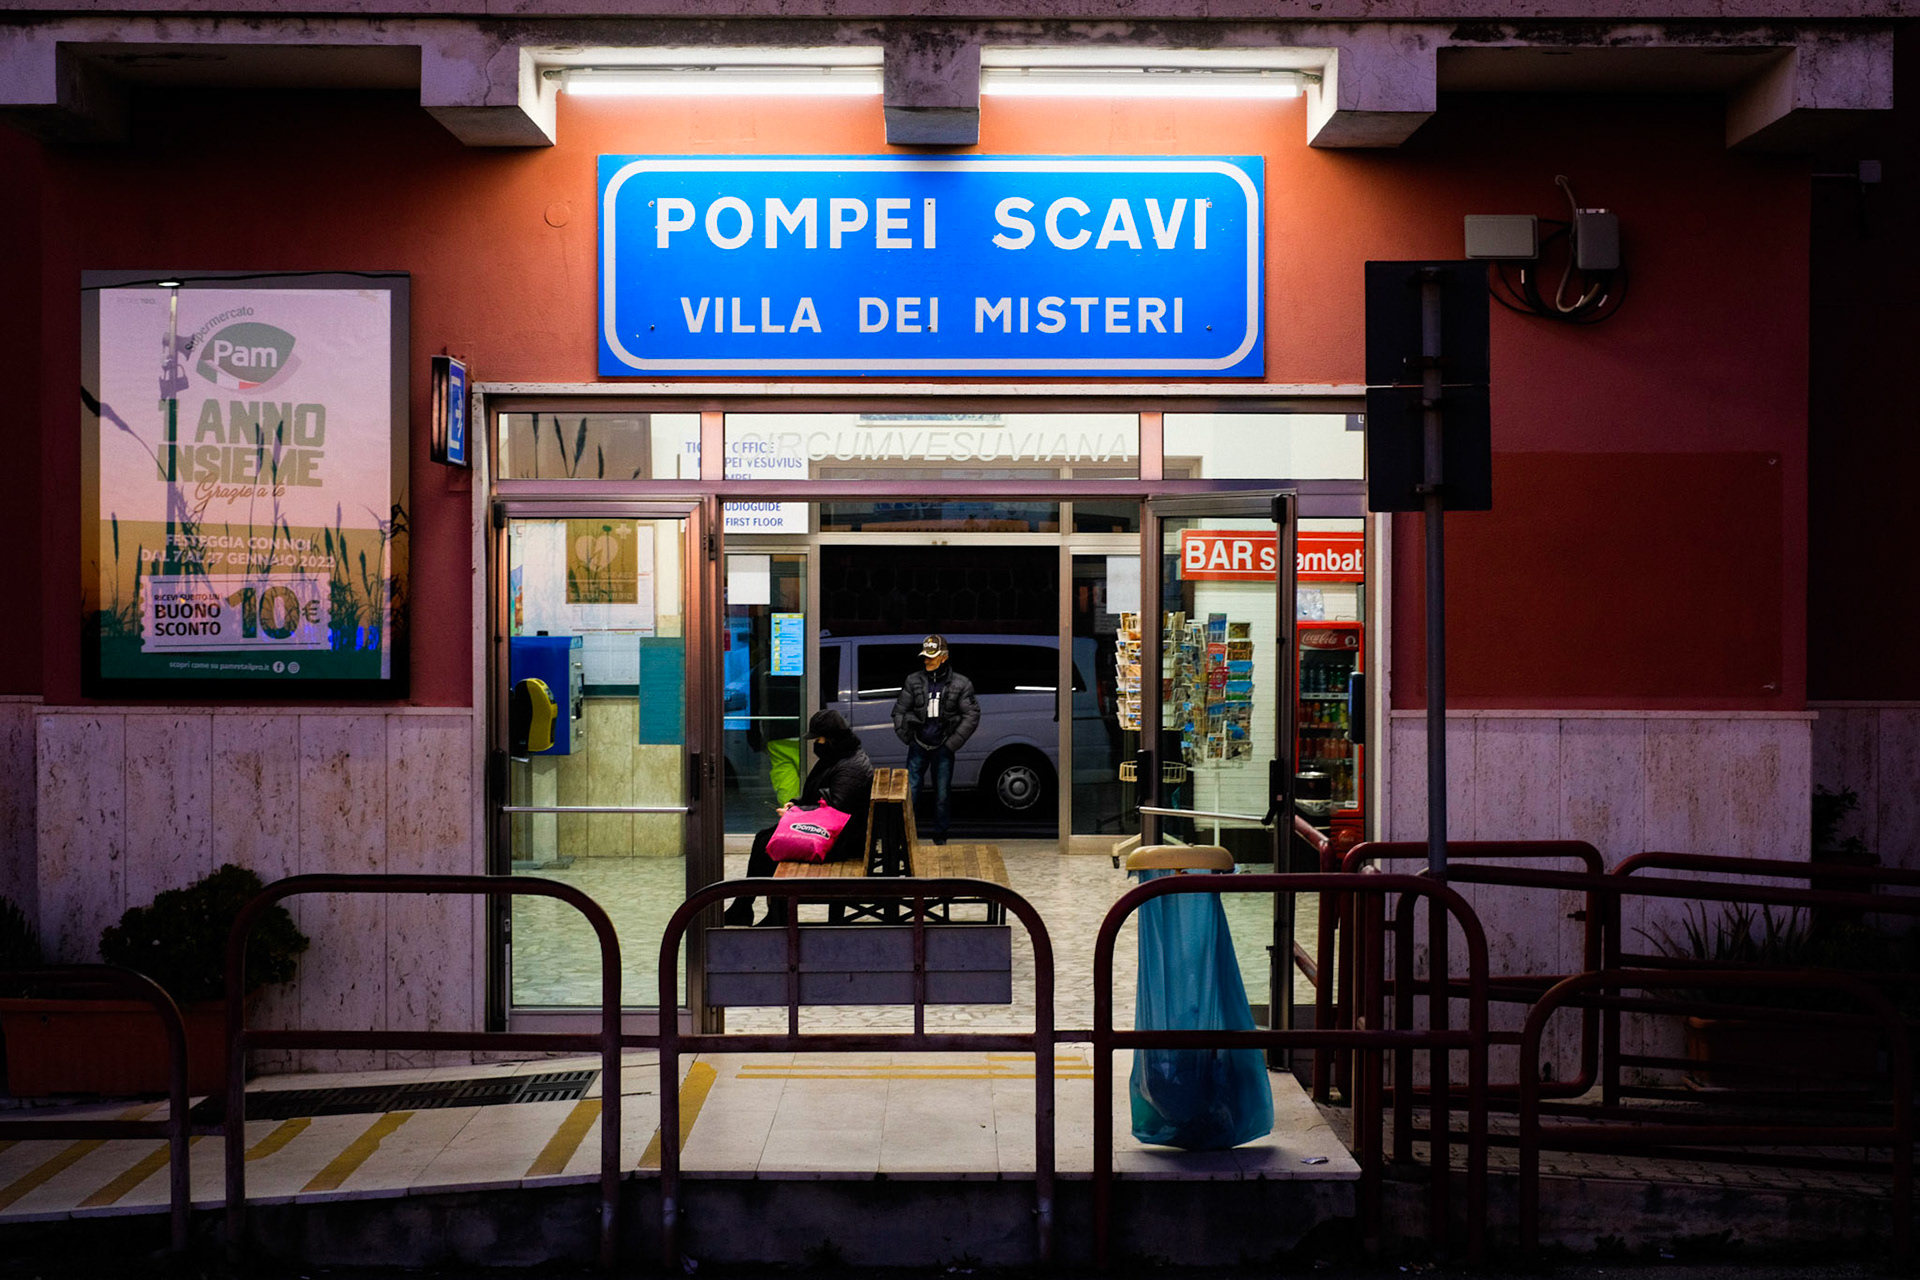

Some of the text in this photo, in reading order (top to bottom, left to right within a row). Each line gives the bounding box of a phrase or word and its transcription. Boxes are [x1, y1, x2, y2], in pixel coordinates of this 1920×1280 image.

[656, 196, 1208, 250] POMPEI SCAVI
[184, 306, 255, 351] Supermercato
[681, 297, 1183, 334] VILLA DEI MISTERI
[213, 339, 279, 368] Pam
[194, 398, 327, 447] ANNO
[740, 431, 1130, 463] CIRCUMVESUVIANA
[157, 443, 325, 487] INSIEME
[747, 456, 803, 469] VESUVIUS
[194, 472, 286, 514] Grazie a te
[724, 501, 782, 512] UDIOGUIDE
[725, 517, 784, 527] FIRST FLOOR
[166, 533, 312, 551] FESTEGGIA CON NOI
[1185, 539, 1253, 570] BAR
[140, 549, 336, 568] DAL 7 AL 27 GENNAIO 2022
[154, 593, 178, 601] RICEVI
[154, 603, 221, 619] BUONO
[154, 621, 221, 637] SCONTO
